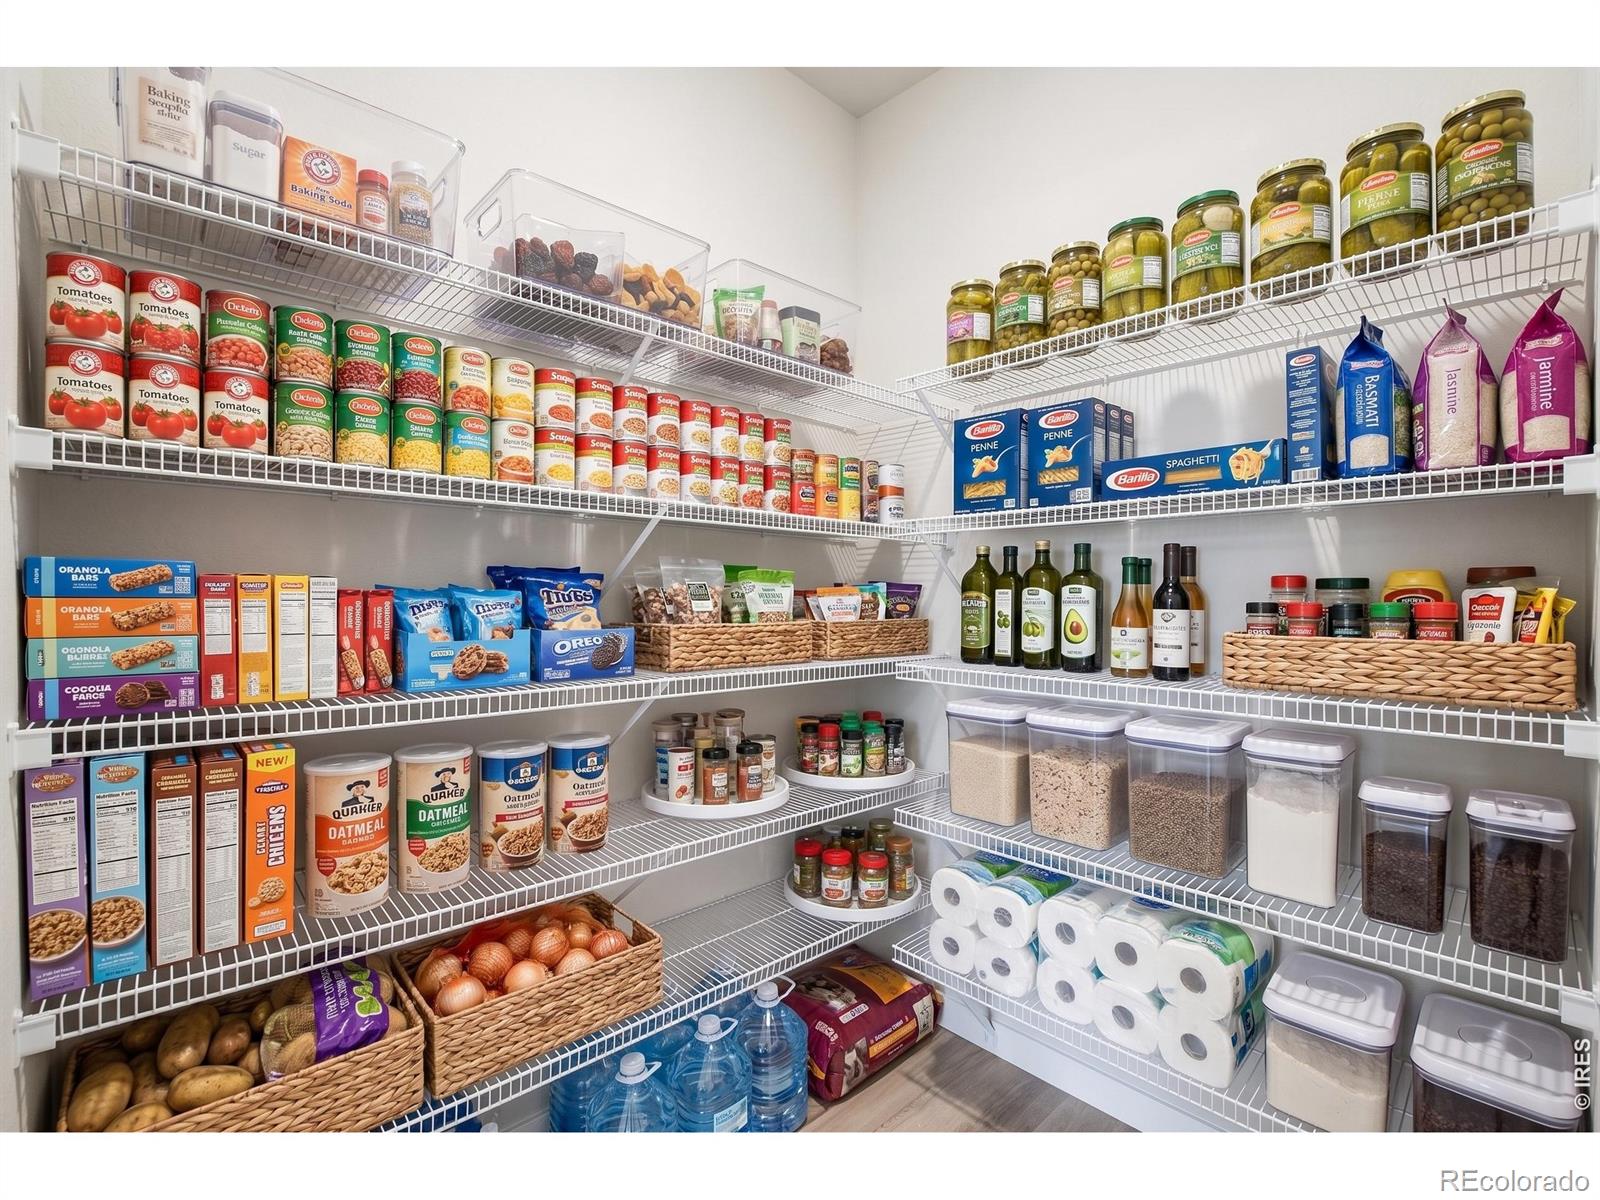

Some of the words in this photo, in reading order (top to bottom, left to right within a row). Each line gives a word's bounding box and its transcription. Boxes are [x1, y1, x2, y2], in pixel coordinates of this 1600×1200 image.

[148, 85, 191, 109] Baking
[290, 184, 326, 202] Baking
[329, 195, 353, 209] Soda
[57, 286, 113, 304] Tomatoes
[139, 302, 190, 320] Tomatoes
[57, 376, 113, 392] Tomatoes
[139, 389, 190, 404] Tomatoes
[1364, 374, 1380, 427] BASMATI
[214, 400, 262, 415] Tomatoes
[1043, 429, 1073, 441] PENNE
[970, 440, 999, 452] PENNE
[1166, 454, 1220, 469] SPAGHETTI
[1117, 470, 1156, 485] Barilla
[58, 566, 111, 574] ORANOLA
[71, 574, 99, 582] BARS
[60, 606, 112, 614] ORANOLA
[72, 613, 100, 621] BARS
[553, 636, 603, 655] OREO
[255, 755, 289, 769] NEW!
[573, 778, 607, 791] Oatmeal
[503, 788, 541, 803] Oatmeal
[418, 802, 468, 822] OATMEAL
[328, 817, 386, 839] OATMEAL
